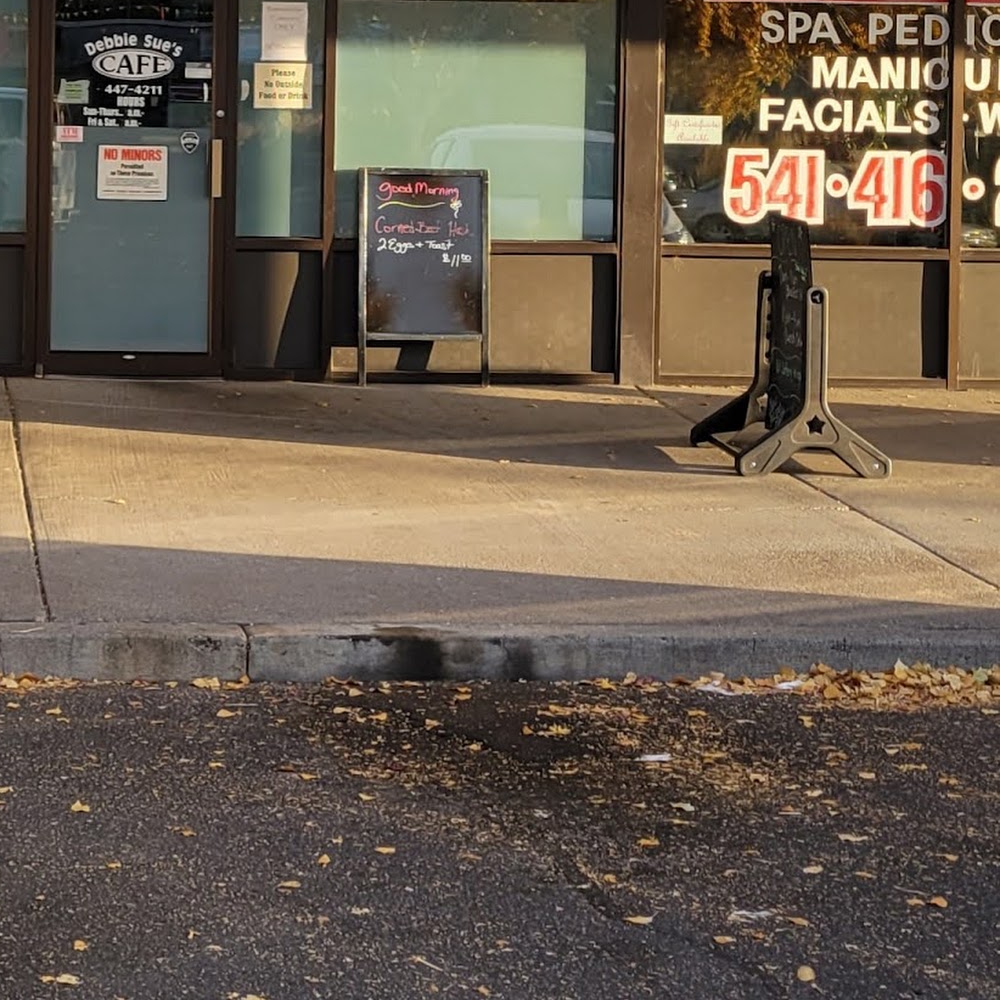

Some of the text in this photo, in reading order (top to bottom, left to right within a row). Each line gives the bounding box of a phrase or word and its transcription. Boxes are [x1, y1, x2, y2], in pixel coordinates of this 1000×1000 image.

[760, 10, 841, 45] SPA
[84, 32, 183, 57] Debbie Sue's
[99, 54, 170, 75] CAFE
[104, 84, 162, 95] 447-4211
[275, 80, 302, 88] Outside
[117, 96, 145, 107] HOURS
[258, 91, 276, 99] Food
[87, 117, 97, 126] Fri
[759, 98, 940, 134] FACIALS
[103, 148, 162, 161] NO MINORS
[415, 182, 459, 202] Morning
[375, 215, 415, 234] Corned
[425, 239, 455, 251] Toast
